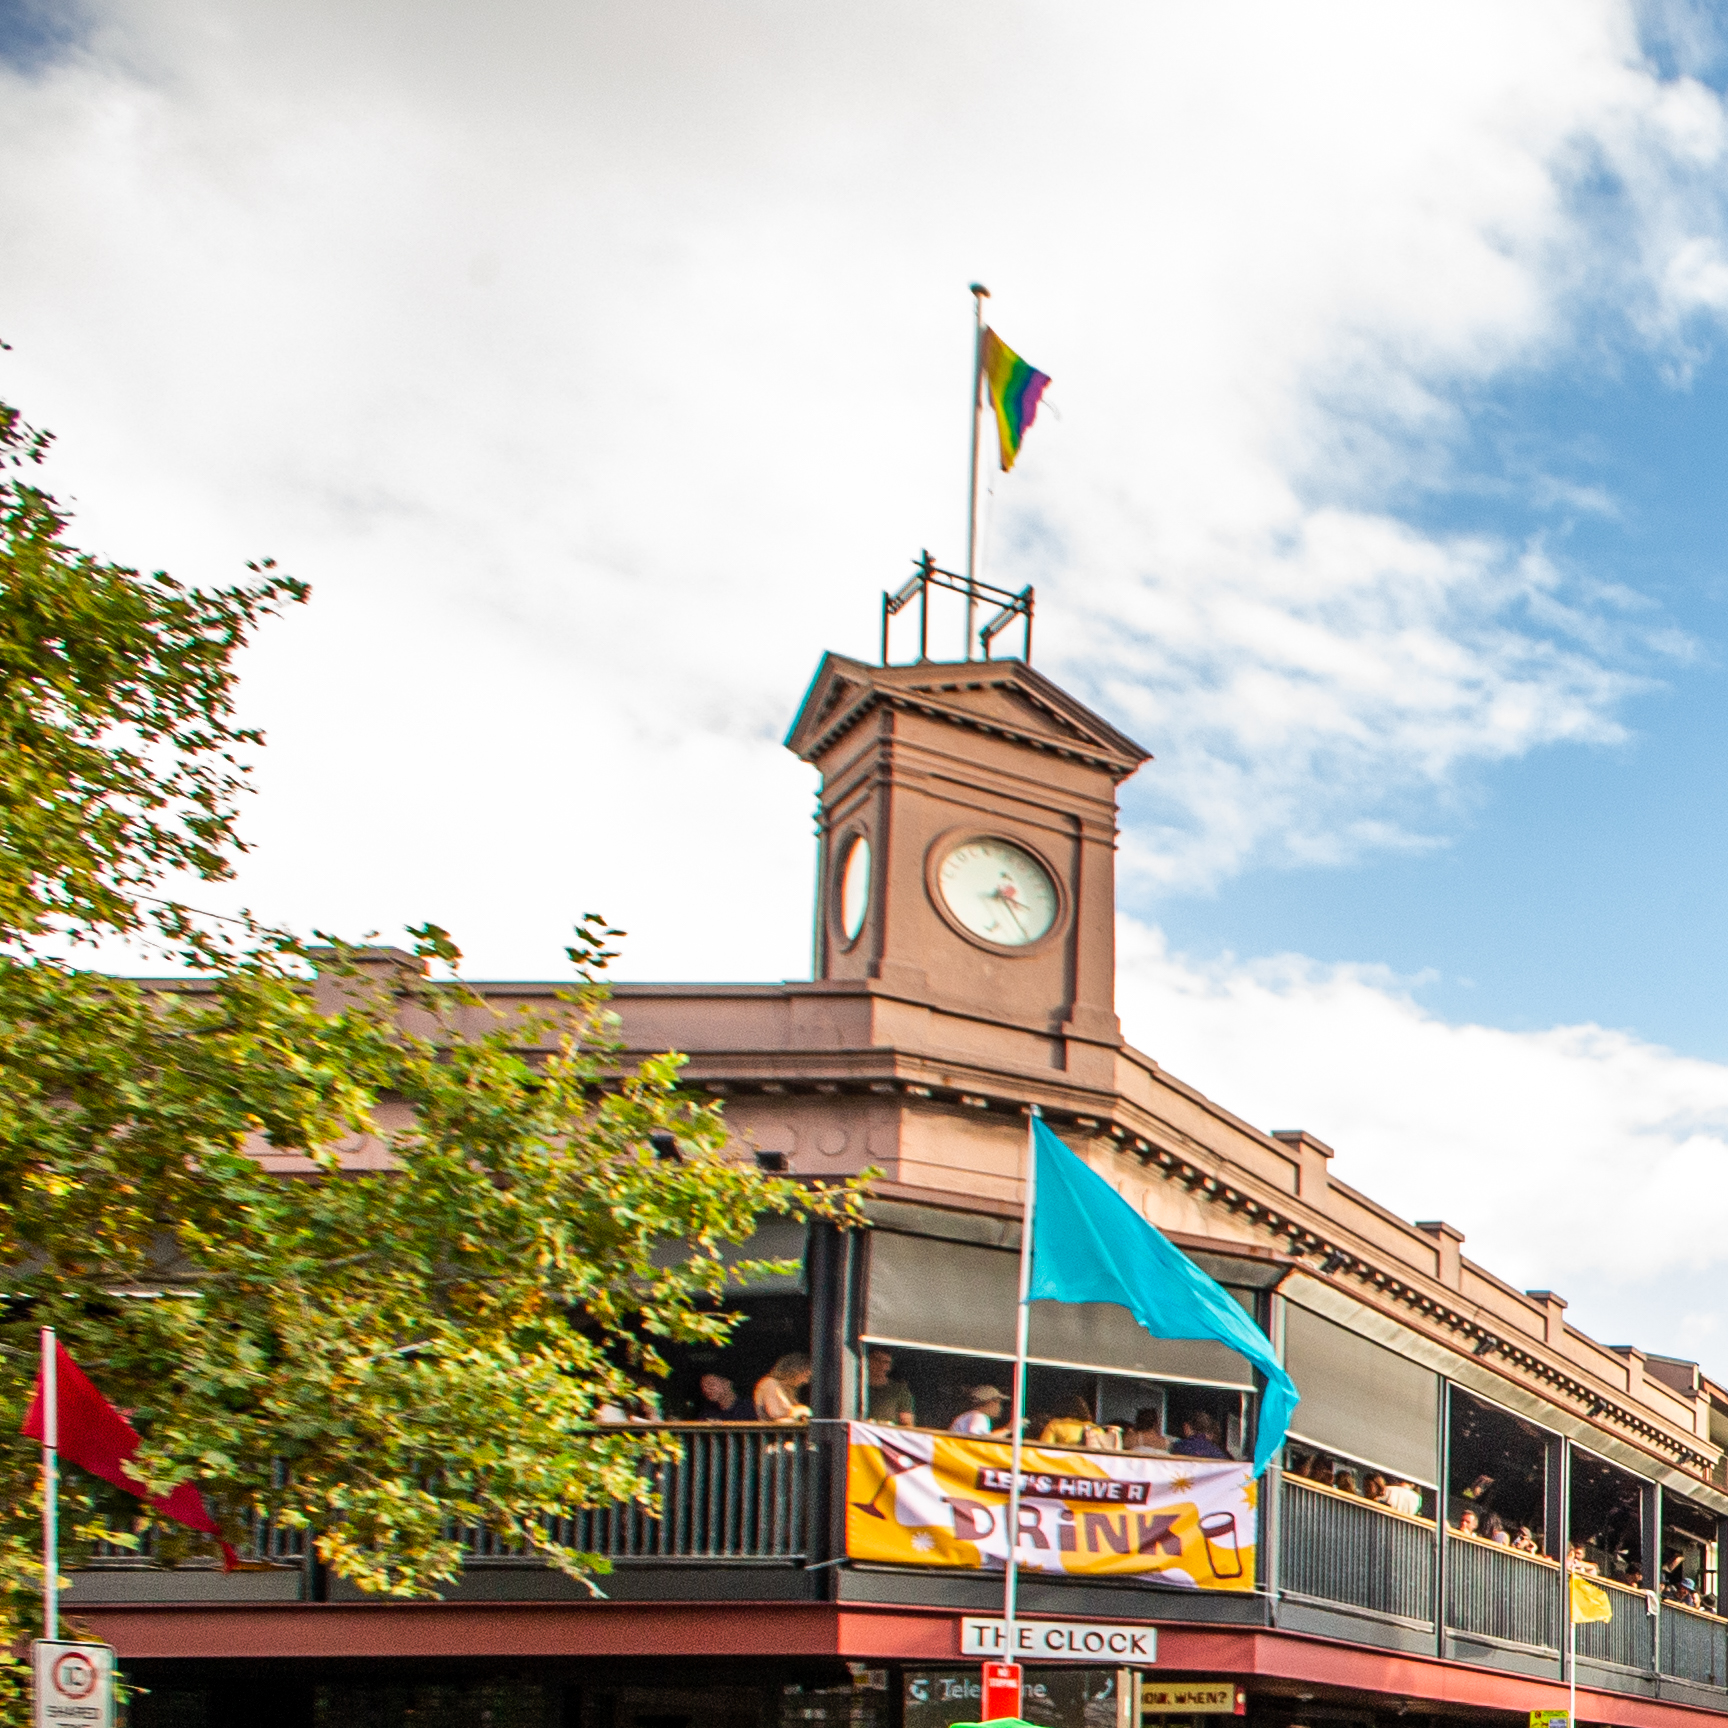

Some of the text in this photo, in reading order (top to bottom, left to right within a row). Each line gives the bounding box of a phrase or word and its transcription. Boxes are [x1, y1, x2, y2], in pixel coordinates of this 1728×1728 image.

[983, 1468, 1144, 1501] LET'S HAVE A
[970, 1624, 1148, 1654] THE CLOCK
[940, 1678, 1047, 1699] Telene
